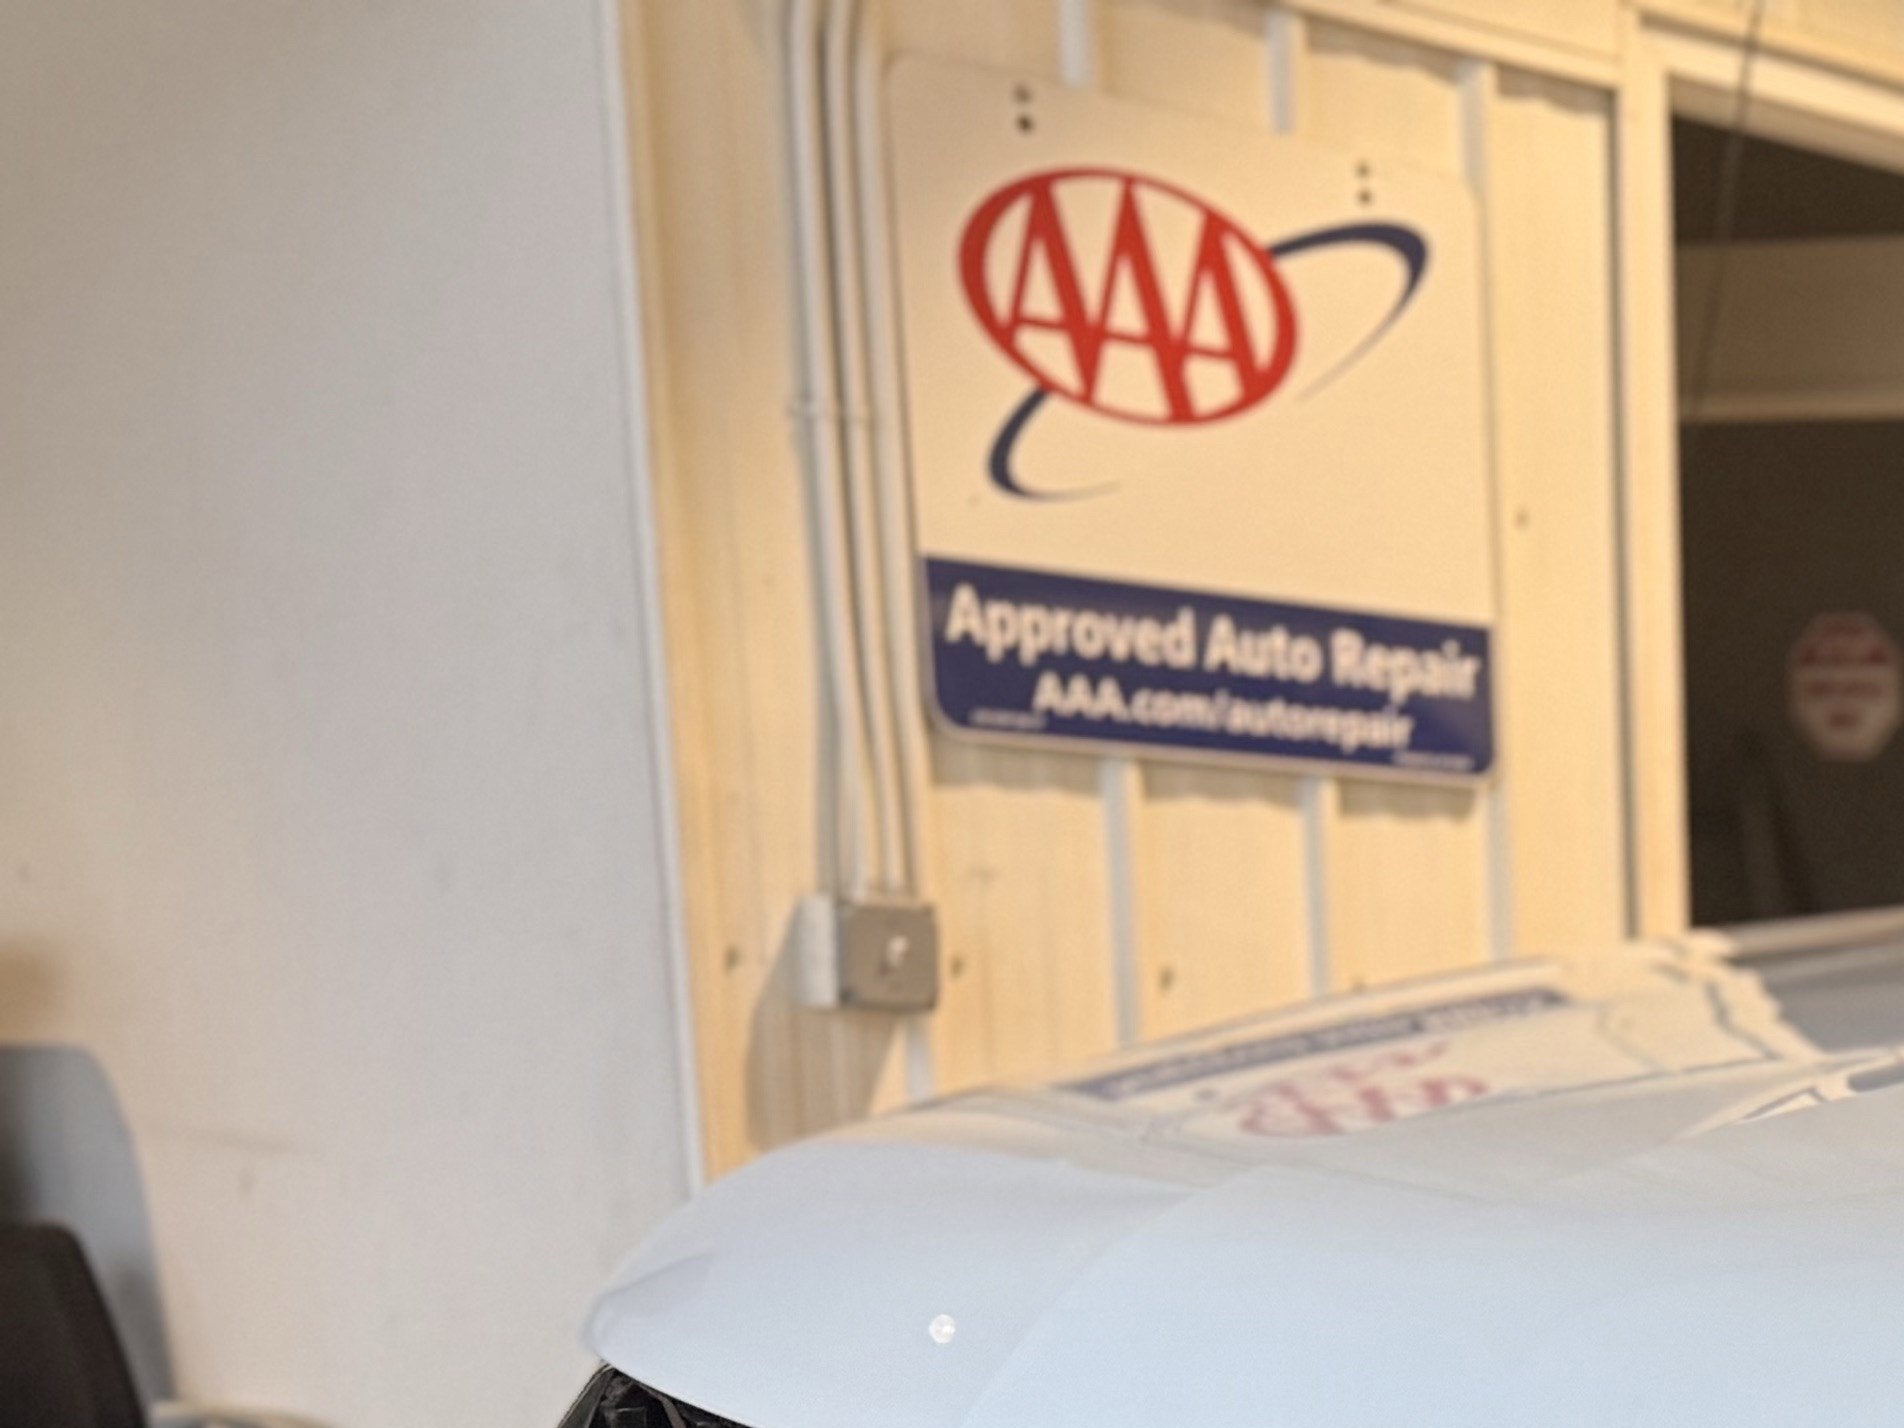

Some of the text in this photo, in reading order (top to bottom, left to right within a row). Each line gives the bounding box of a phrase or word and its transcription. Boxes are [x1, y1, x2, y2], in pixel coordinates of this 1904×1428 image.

[992, 168, 1278, 428] AAA
[945, 581, 1481, 707] Approved Auto Repair
[1031, 669, 1415, 755] AAA.com/autorepair
